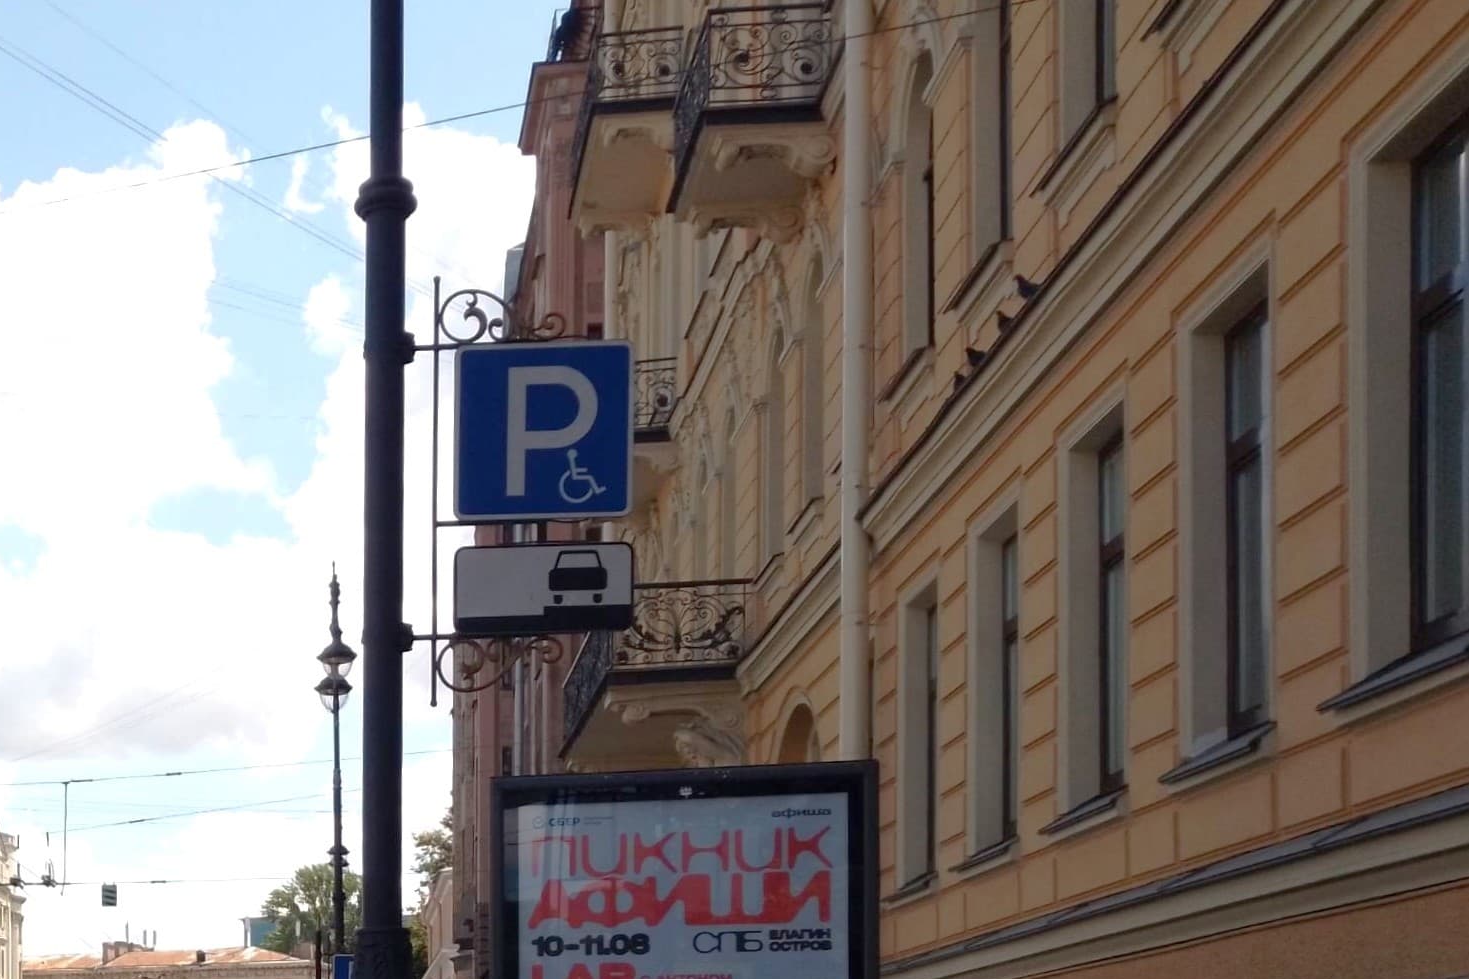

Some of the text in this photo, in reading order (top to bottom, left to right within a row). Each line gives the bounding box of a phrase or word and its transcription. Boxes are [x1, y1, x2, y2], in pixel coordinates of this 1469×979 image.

[506, 365, 598, 496] P
[533, 825, 833, 877] ПИКНИК
[528, 870, 831, 929] АФИШИ
[531, 933, 650, 957] 10-11.08
[693, 930, 764, 954] СПБ
[769, 928, 831, 940] ЕЛАГИН
[769, 940, 832, 952] ОСТРОВ
